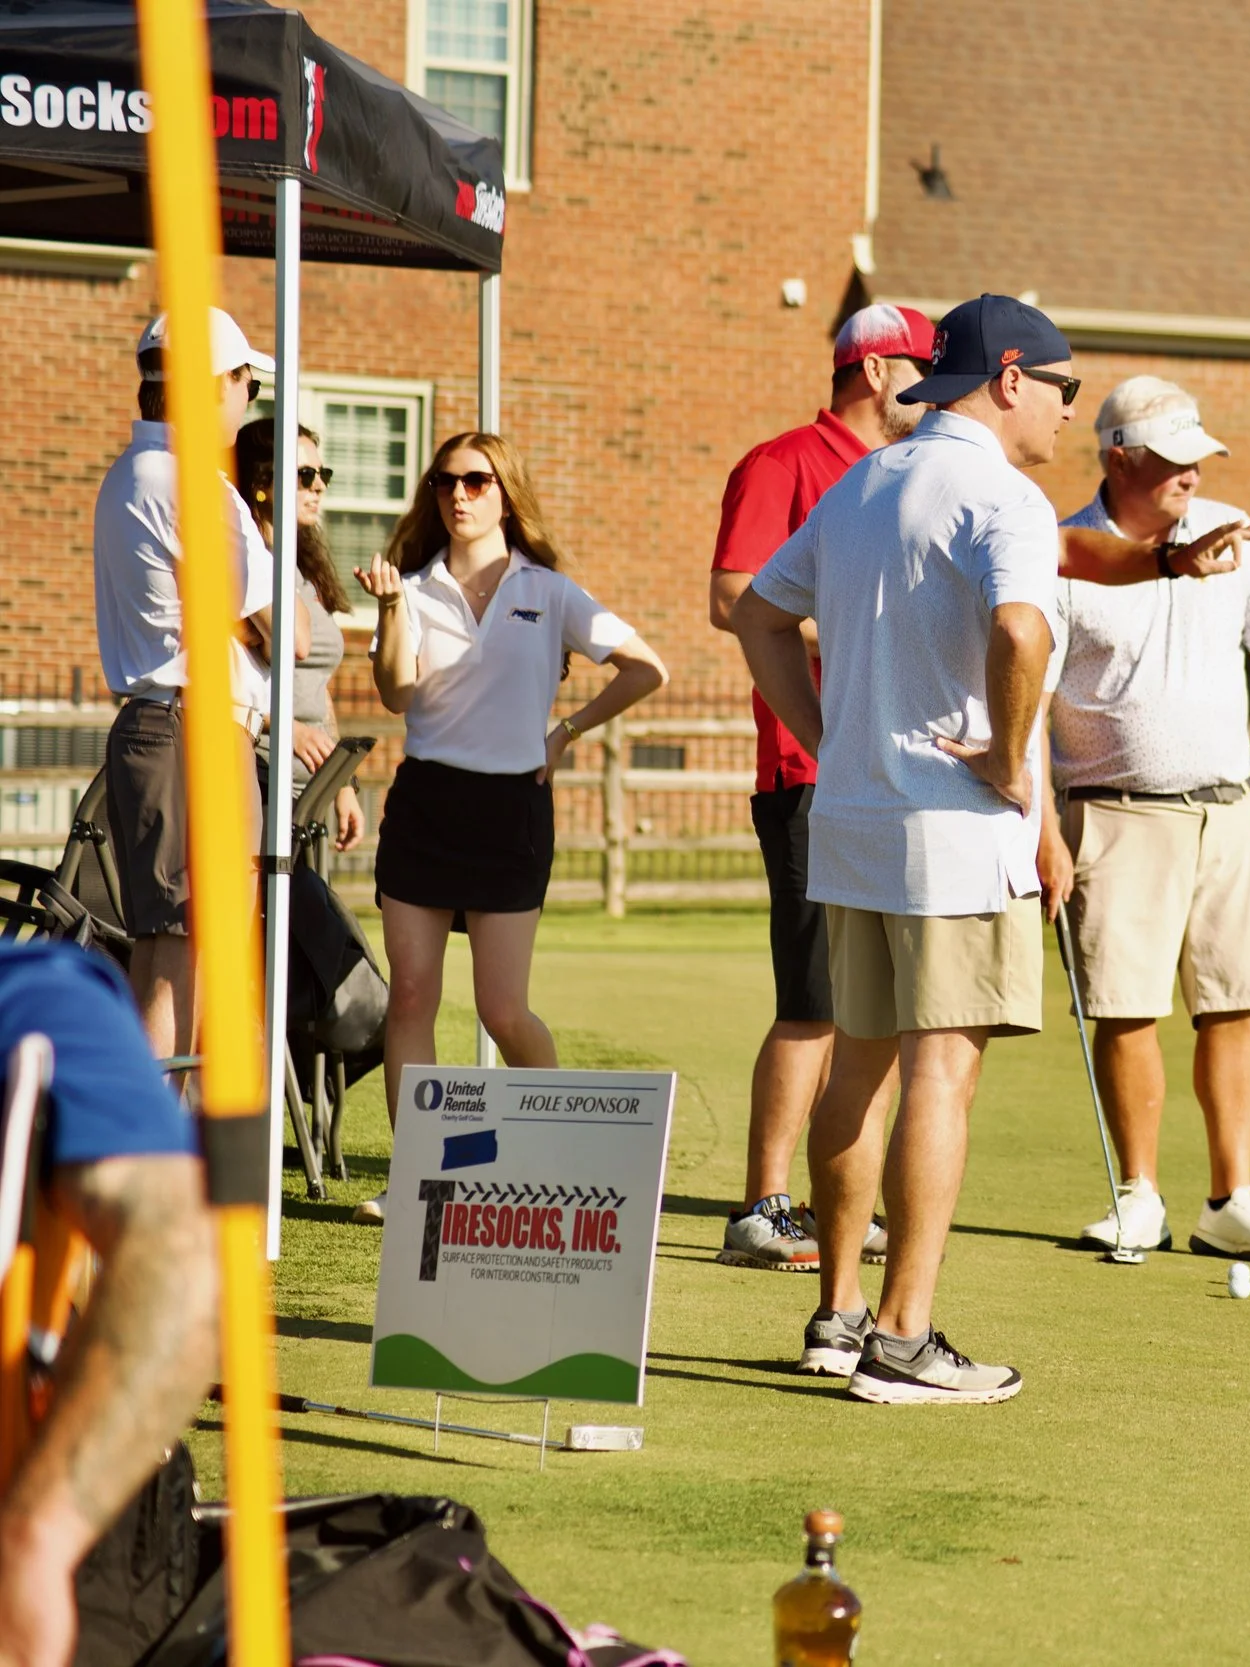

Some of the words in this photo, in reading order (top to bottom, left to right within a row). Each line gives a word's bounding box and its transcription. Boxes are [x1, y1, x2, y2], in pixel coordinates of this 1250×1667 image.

[446, 1080, 486, 1096] United
[443, 1096, 487, 1112] Rentals
[519, 1094, 562, 1111] HOLE
[564, 1096, 640, 1114] SPONSOR
[571, 1208, 621, 1254] INC.
[442, 1251, 476, 1264] SURFACE
[476, 1252, 523, 1267] PROTECTION
[523, 1255, 540, 1267] AND
[541, 1256, 571, 1269] SAFETY
[571, 1258, 613, 1272] PRODUCTS
[470, 1268, 486, 1280] FOR
[486, 1268, 520, 1282] INTERIOR
[520, 1270, 580, 1285] CONSTRUCTION
